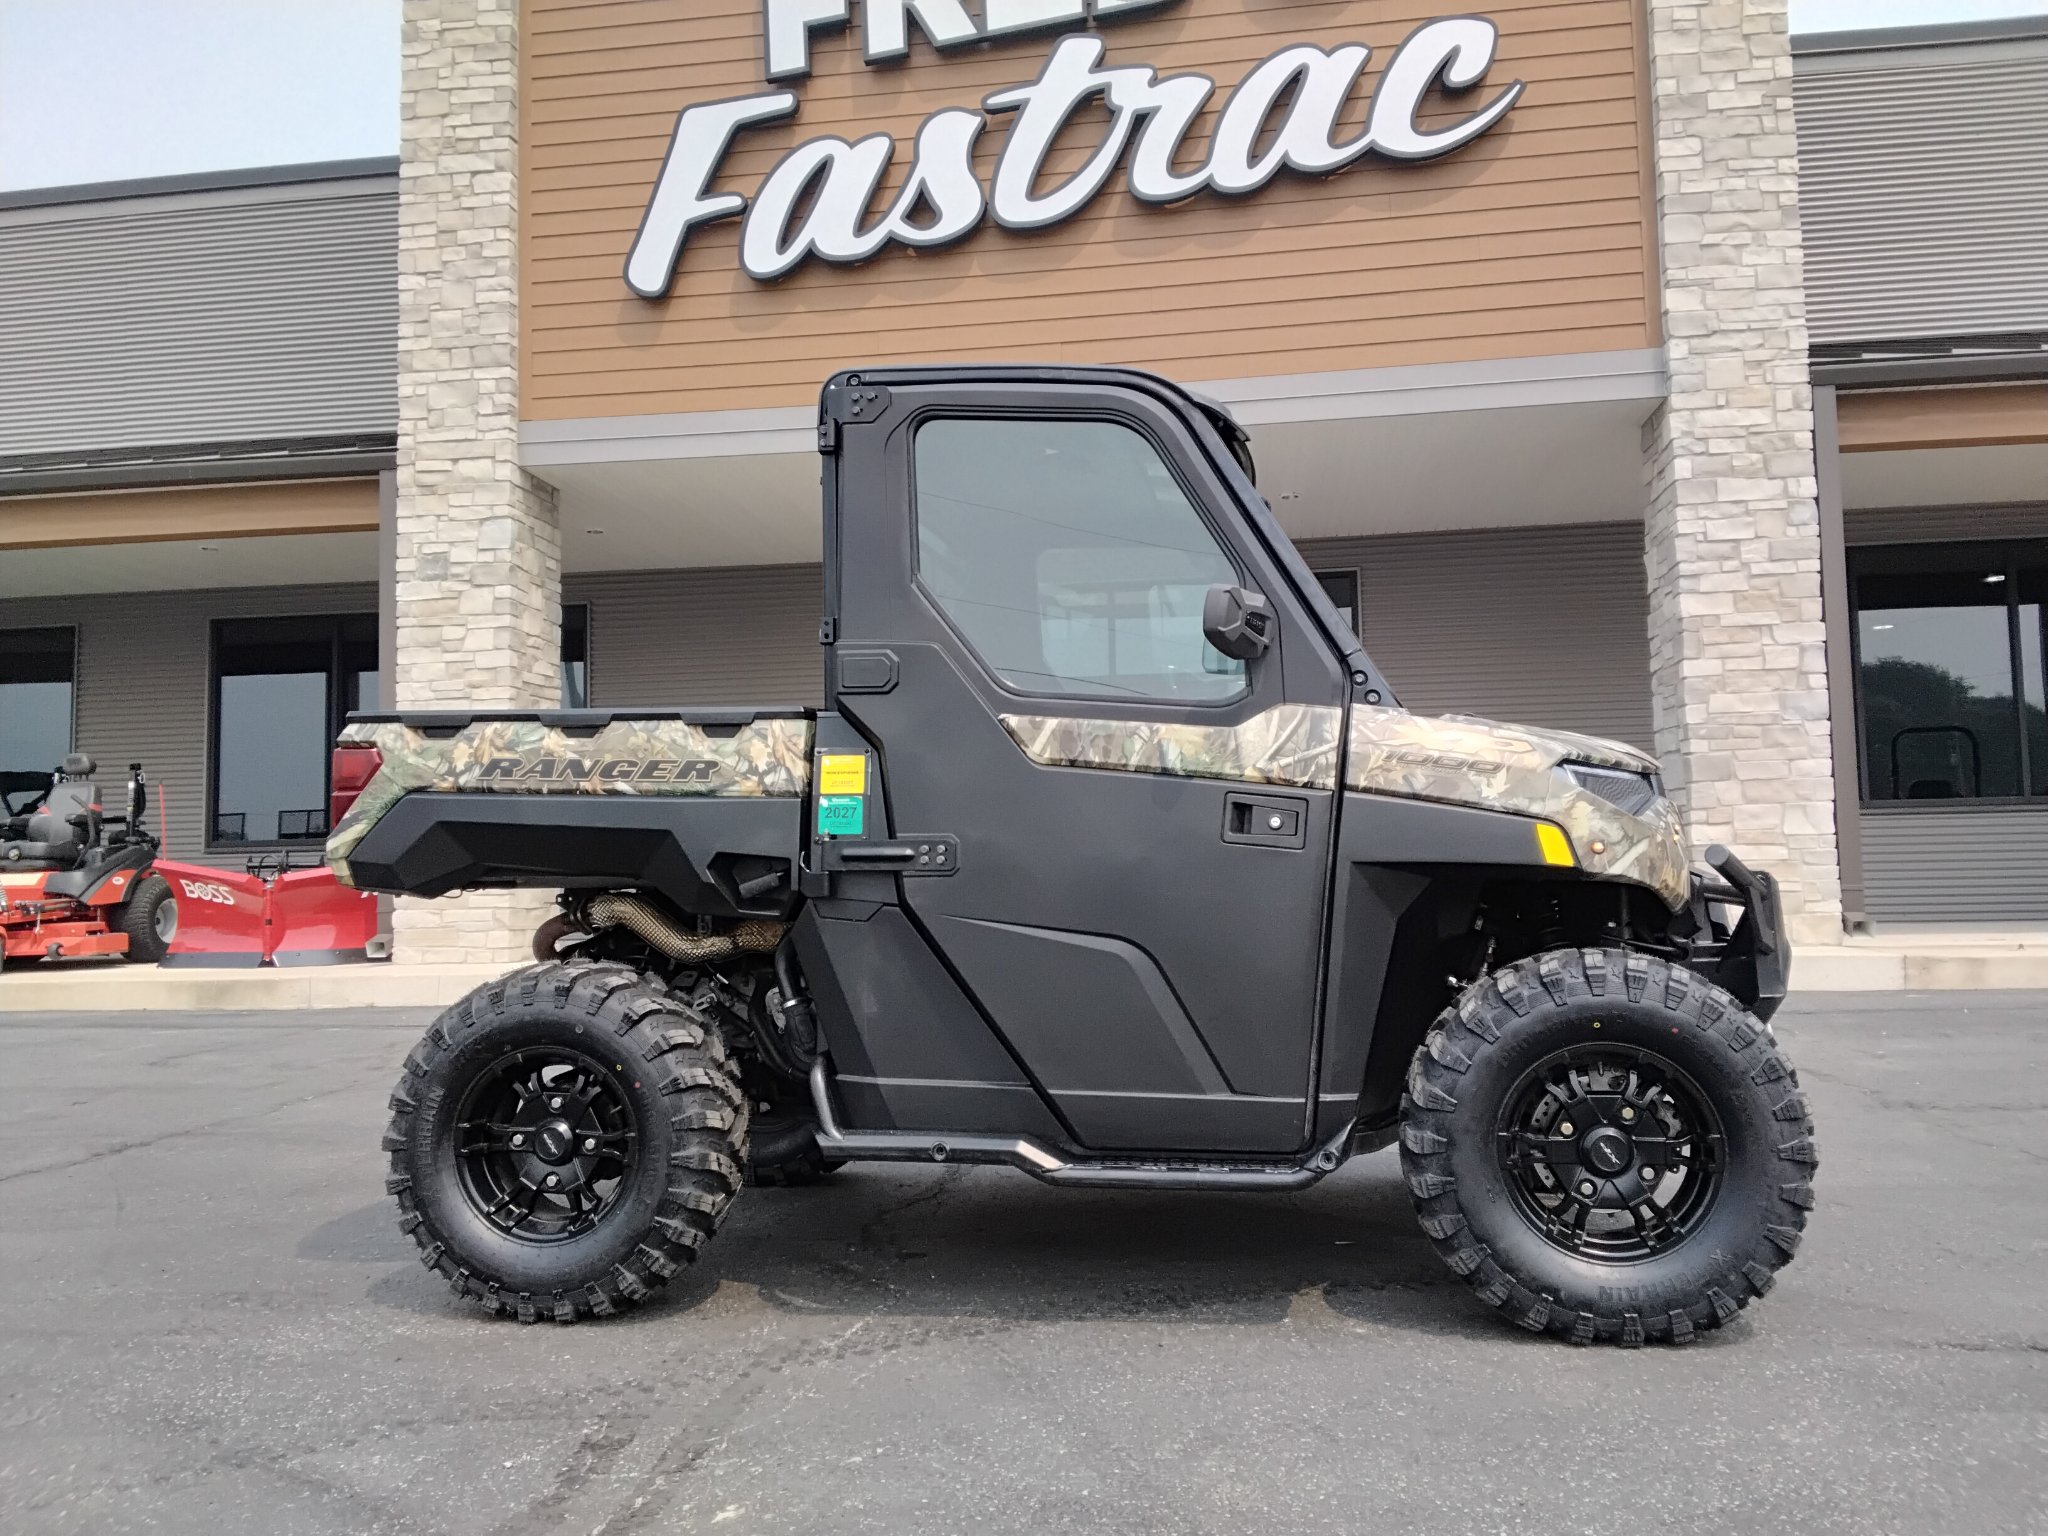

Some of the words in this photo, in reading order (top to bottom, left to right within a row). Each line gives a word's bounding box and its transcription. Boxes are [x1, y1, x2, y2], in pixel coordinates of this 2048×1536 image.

[624, 15, 1525, 299] Fastrac
[477, 757, 720, 782] RANGER
[1382, 750, 1505, 774] 1000
[825, 807, 857, 819] 2027
[180, 880, 234, 905] BOSS
